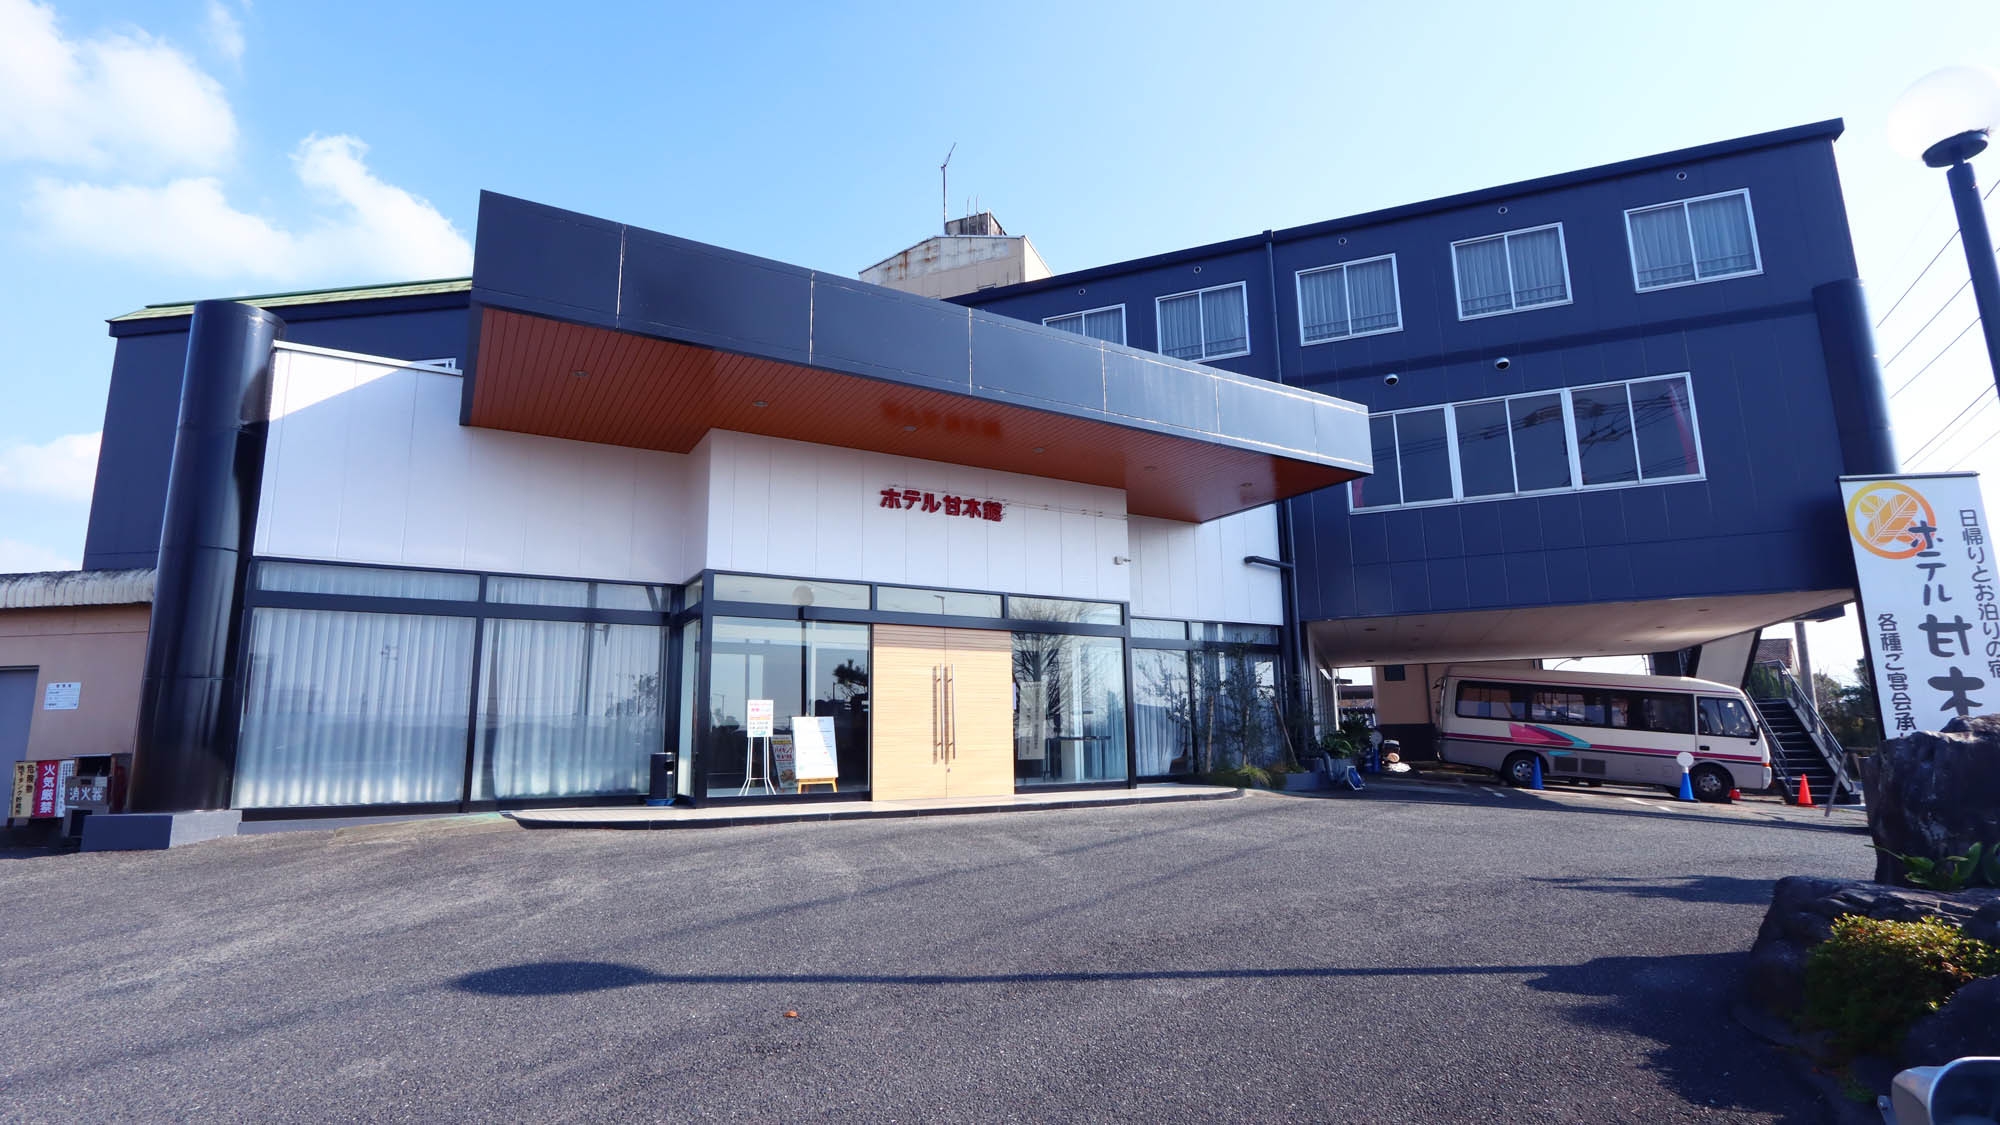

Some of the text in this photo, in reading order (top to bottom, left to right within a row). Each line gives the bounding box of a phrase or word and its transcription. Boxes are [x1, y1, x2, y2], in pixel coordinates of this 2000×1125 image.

[880, 488, 1003, 522] ホテル甘木館
[1878, 613, 1917, 738] 各種ご宴会承
[40, 764, 56, 814] 火気厳禁
[69, 786, 103, 801] 消火器
